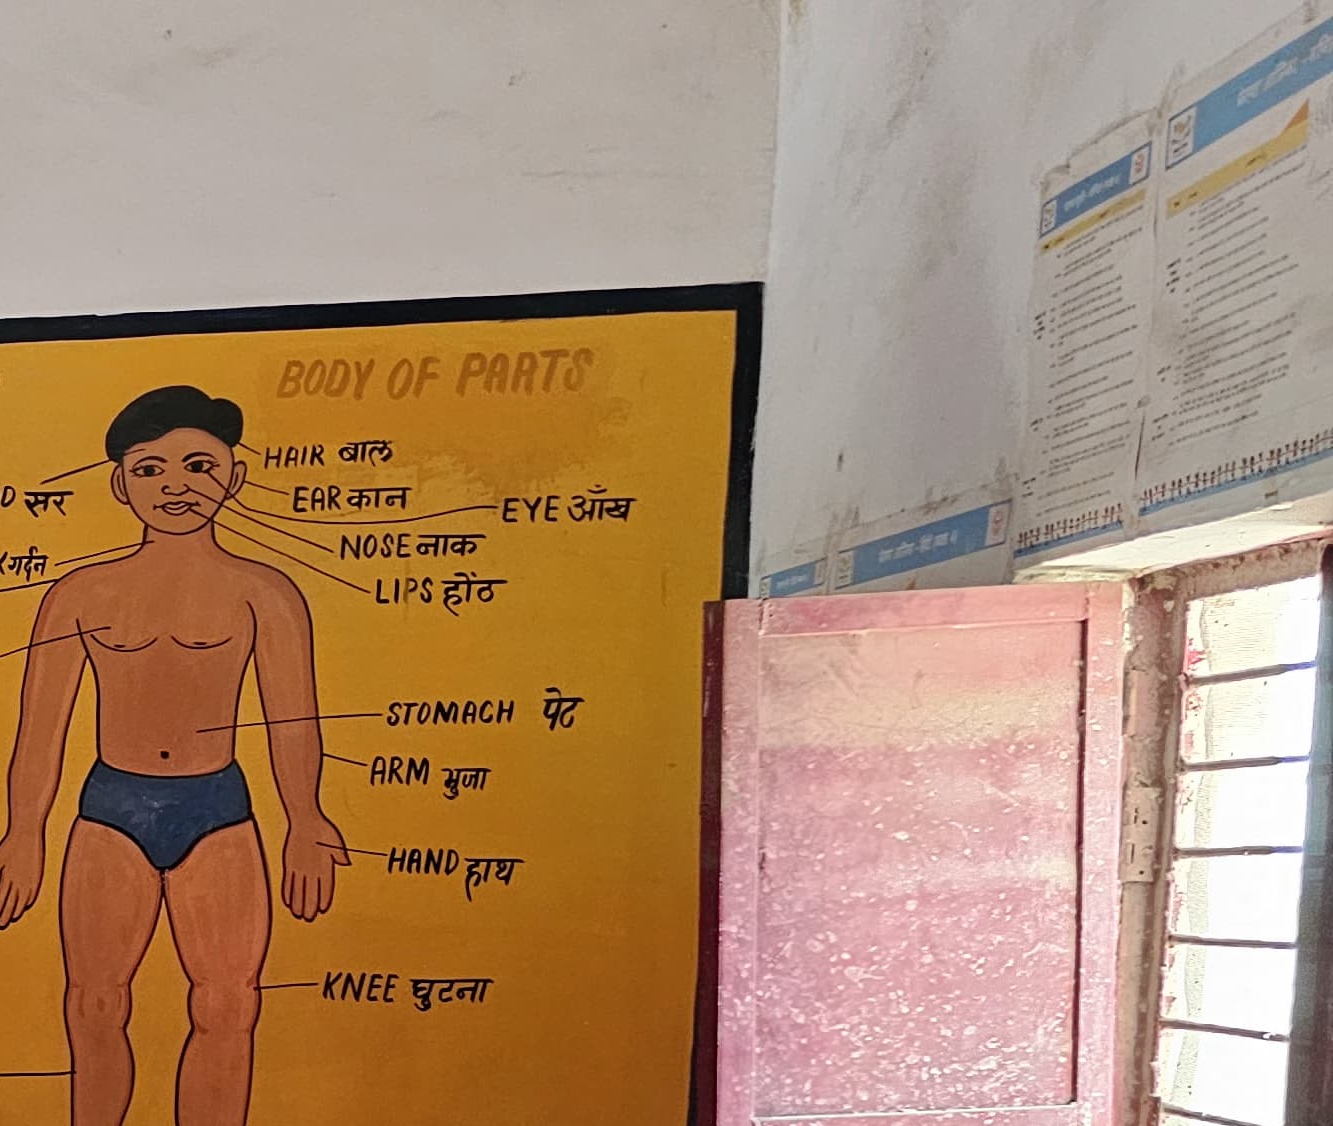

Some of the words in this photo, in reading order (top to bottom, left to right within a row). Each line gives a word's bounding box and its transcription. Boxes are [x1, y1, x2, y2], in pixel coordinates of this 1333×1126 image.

[277, 358, 375, 400] BODY
[386, 356, 441, 400] OF
[455, 348, 595, 397] PARTS
[264, 445, 325, 470] HAIR
[338, 440, 394, 467] बाल
[292, 486, 342, 513] EAR
[346, 486, 413, 512] कान
[502, 496, 561, 523] EYE
[8, 545, 48, 581] गर्दन
[340, 533, 411, 560] NOSE
[415, 534, 486, 559] नाक
[375, 576, 433, 605] LIPS
[386, 699, 516, 726] STOMACH
[542, 687, 585, 731] पेट
[370, 756, 431, 786] ARM
[441, 767, 492, 800] भुजा
[387, 847, 459, 876] HAND
[464, 857, 525, 902] हाथ
[322, 971, 400, 1003] KNEE
[409, 977, 494, 1012] घुटना
